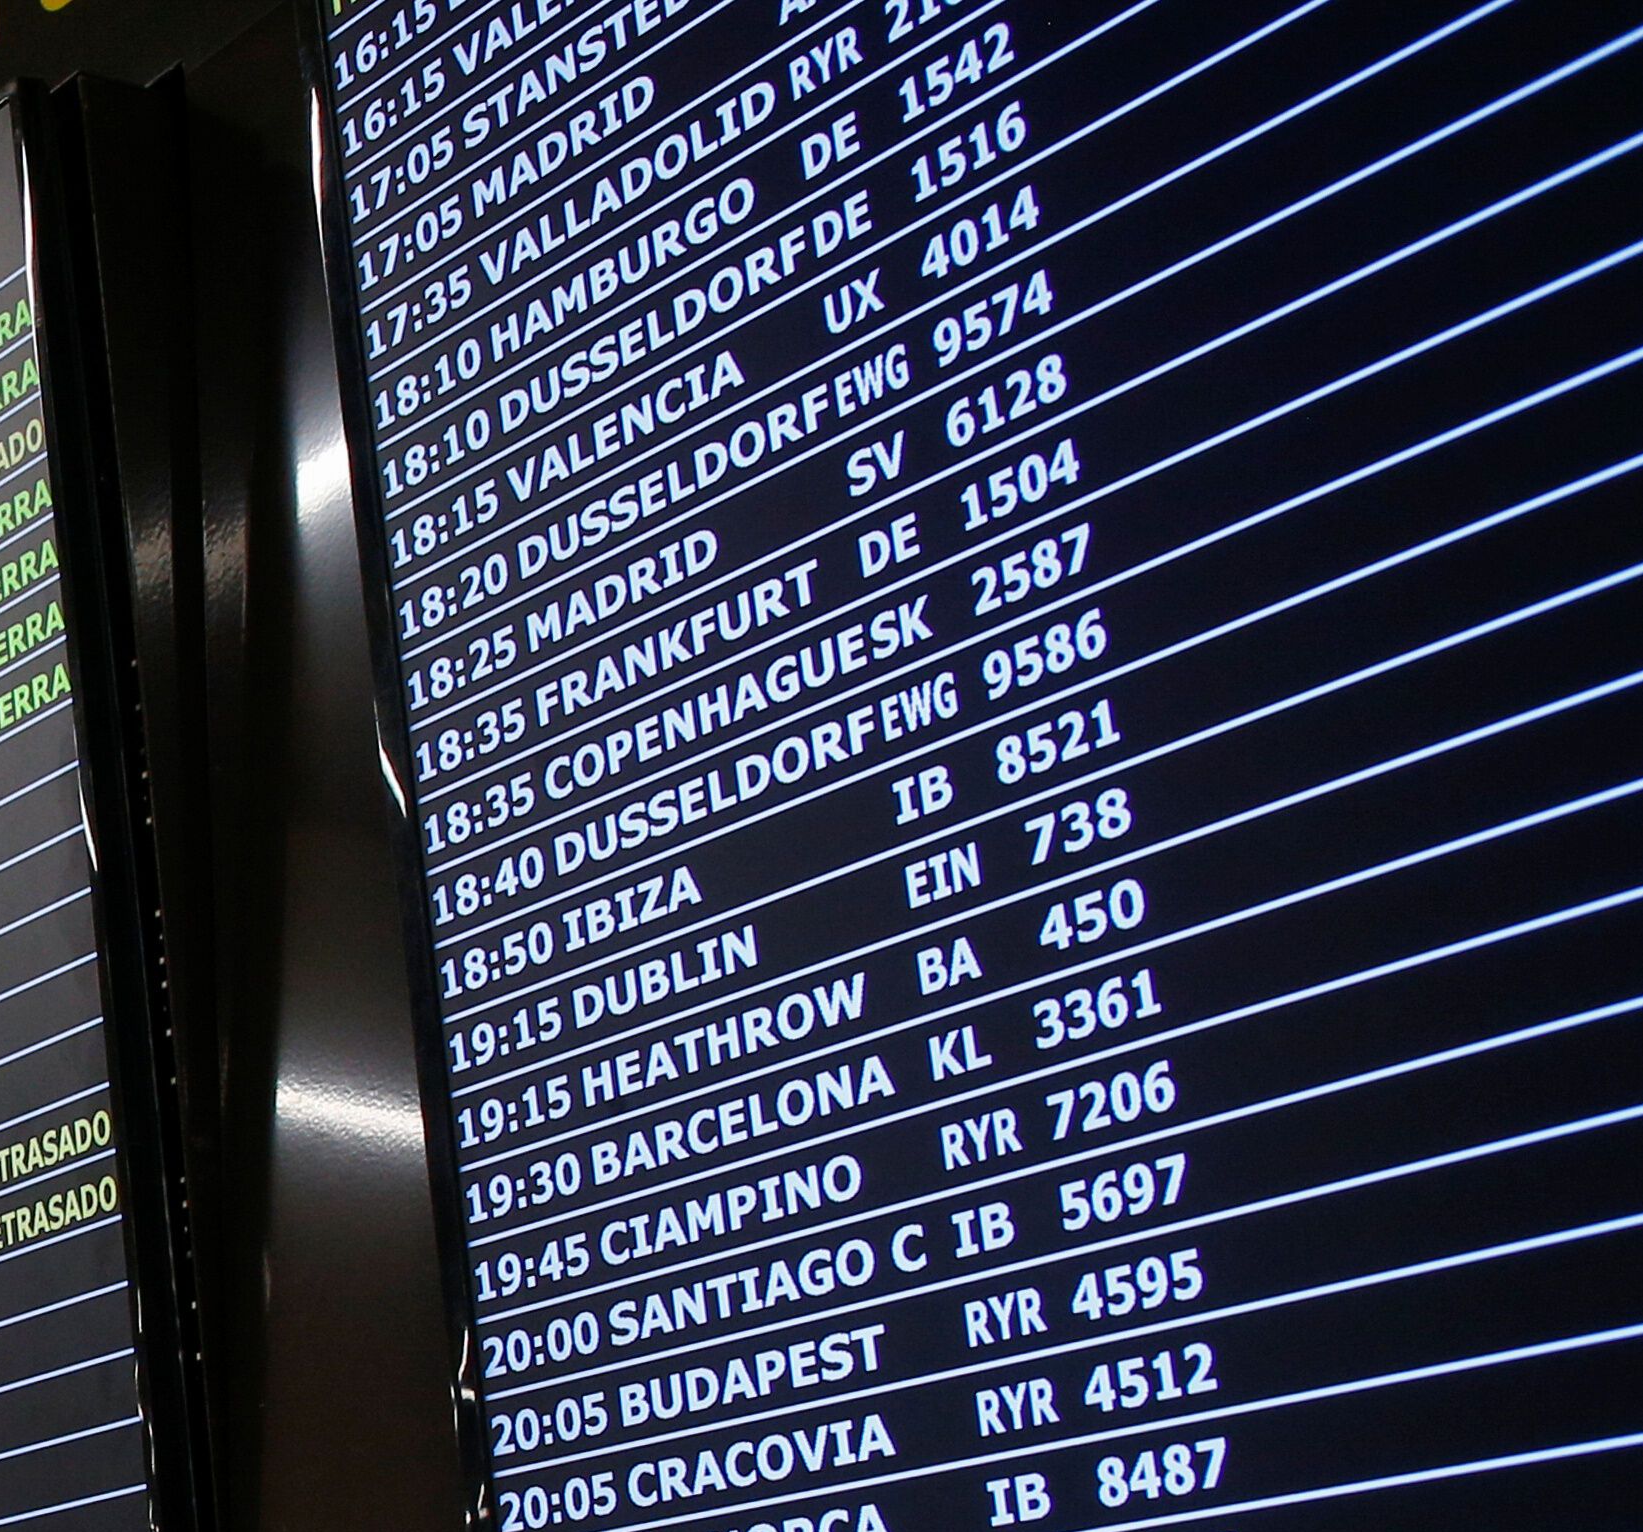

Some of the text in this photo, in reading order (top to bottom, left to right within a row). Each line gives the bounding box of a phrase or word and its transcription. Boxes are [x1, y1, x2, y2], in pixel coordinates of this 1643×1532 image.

[375, 22, 1015, 430] 18:10 HAMBURGO DE 1542
[391, 184, 1040, 569] 18:15 VALENCIA UX 4014
[407, 353, 1068, 711] 18:25 MADRID SV 6128
[440, 698, 1121, 999] 18:50 IBIZA IB 8521
[449, 787, 1132, 1073] 19:15 DUBLIN EIN 738
[466, 968, 1162, 1224] 19:30 BARCELONA KL 3361
[482, 1152, 1186, 1379] 20:00 SANTIAGO C IB 5697
[491, 1248, 1204, 1457] 20:05 BUDAPEST RYR 4595
[986, 1472, 1052, 1527] IB
[1096, 1436, 1227, 1507] 8487
